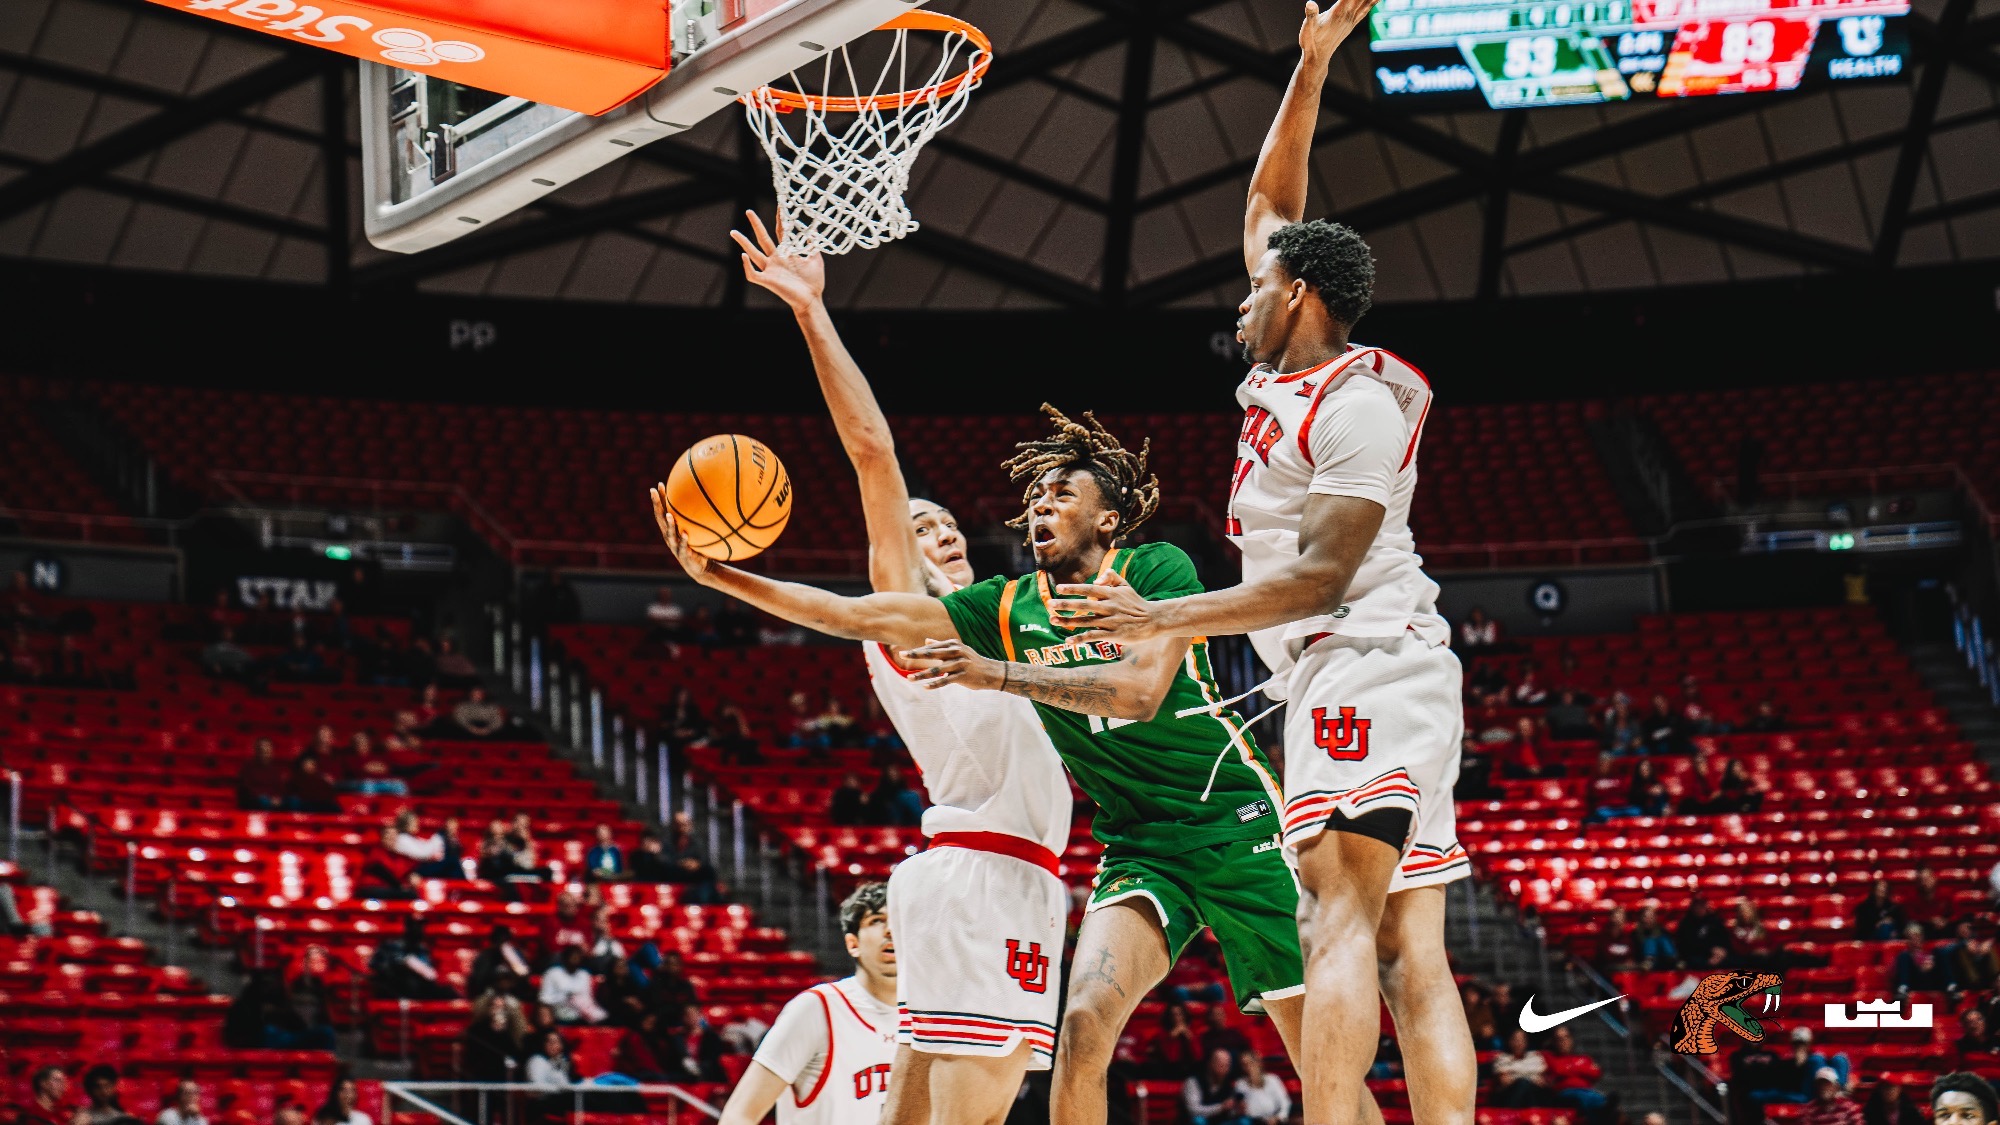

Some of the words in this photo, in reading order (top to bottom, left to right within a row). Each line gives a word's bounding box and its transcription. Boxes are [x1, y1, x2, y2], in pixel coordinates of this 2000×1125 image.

[1503, 36, 1558, 79] 53
[1720, 20, 1776, 63] 83
[1828, 54, 1902, 80] HEALTH
[1239, 404, 1284, 468] TAH
[33, 559, 57, 588] N
[239, 576, 336, 609] UTAH
[1024, 641, 1123, 667] RATTLE
[854, 1063, 891, 1099] UT
